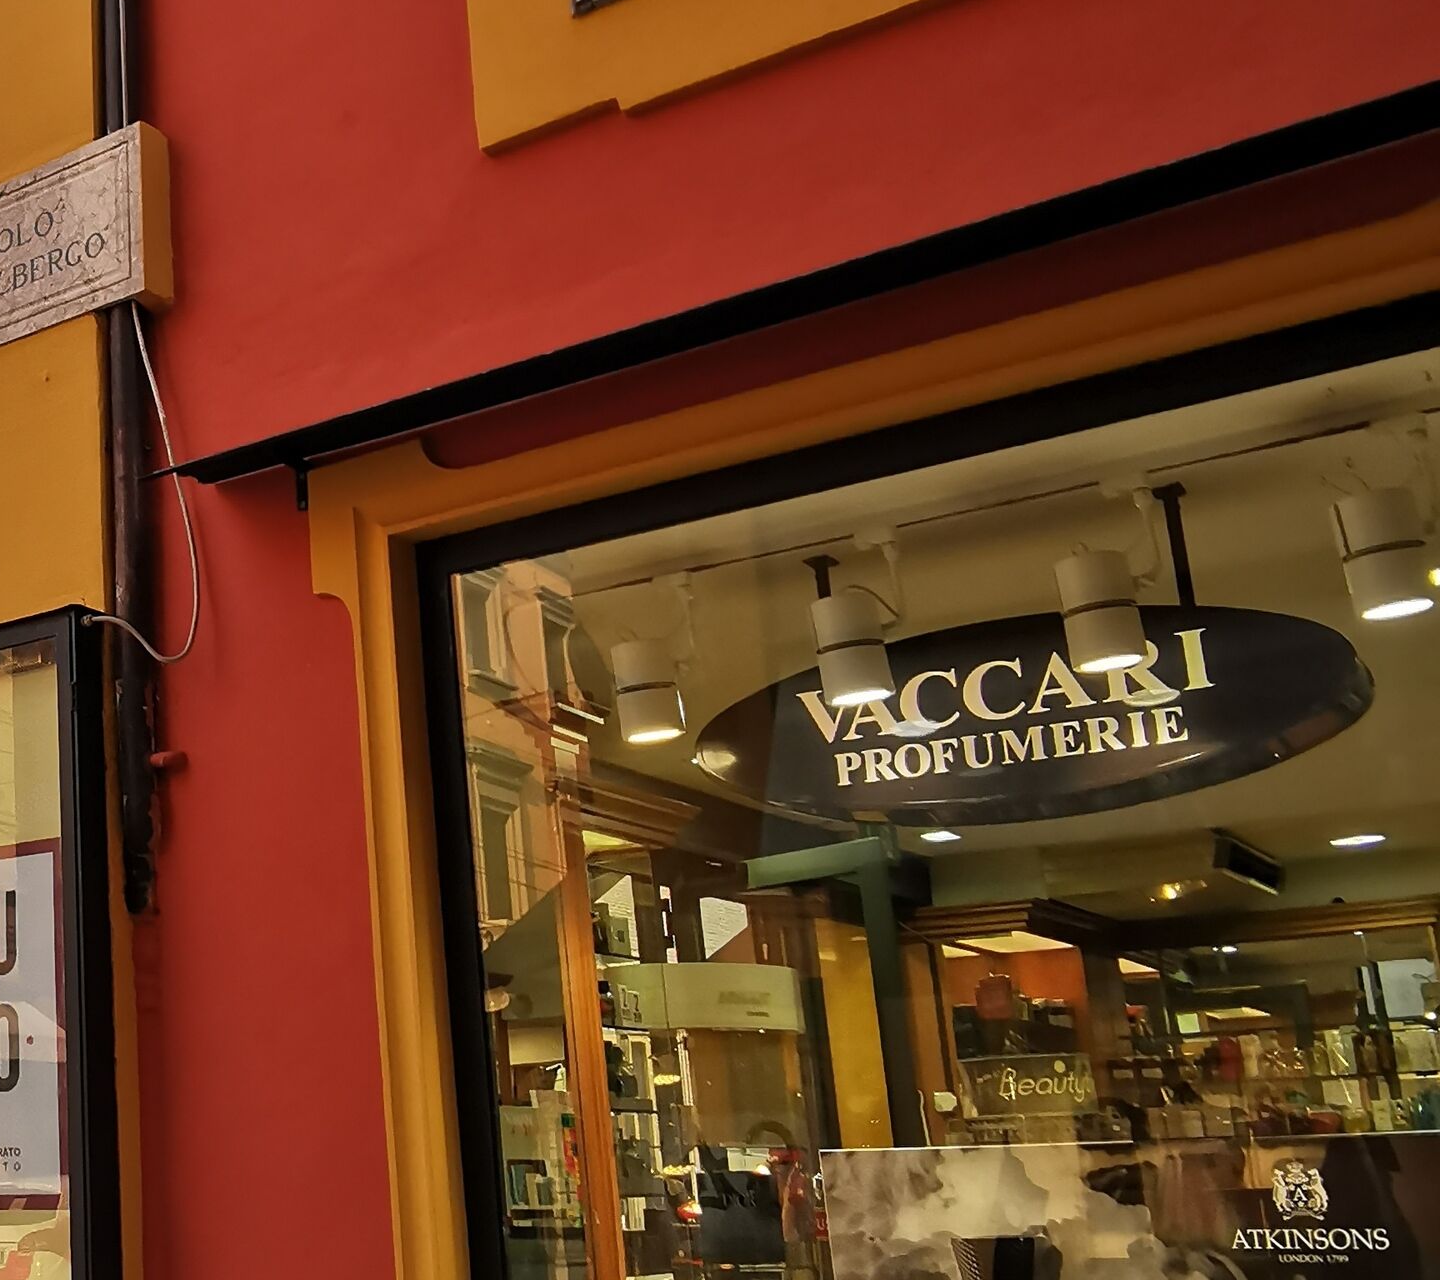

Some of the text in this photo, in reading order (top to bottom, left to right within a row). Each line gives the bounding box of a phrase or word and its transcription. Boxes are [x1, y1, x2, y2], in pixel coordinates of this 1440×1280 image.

[796, 628, 1216, 745] VACCARI
[834, 706, 1190, 787] PROFUMERIE
[1232, 1228, 1391, 1251] ATKINSONS
[1278, 1254, 1350, 1263] LONDON 1799
